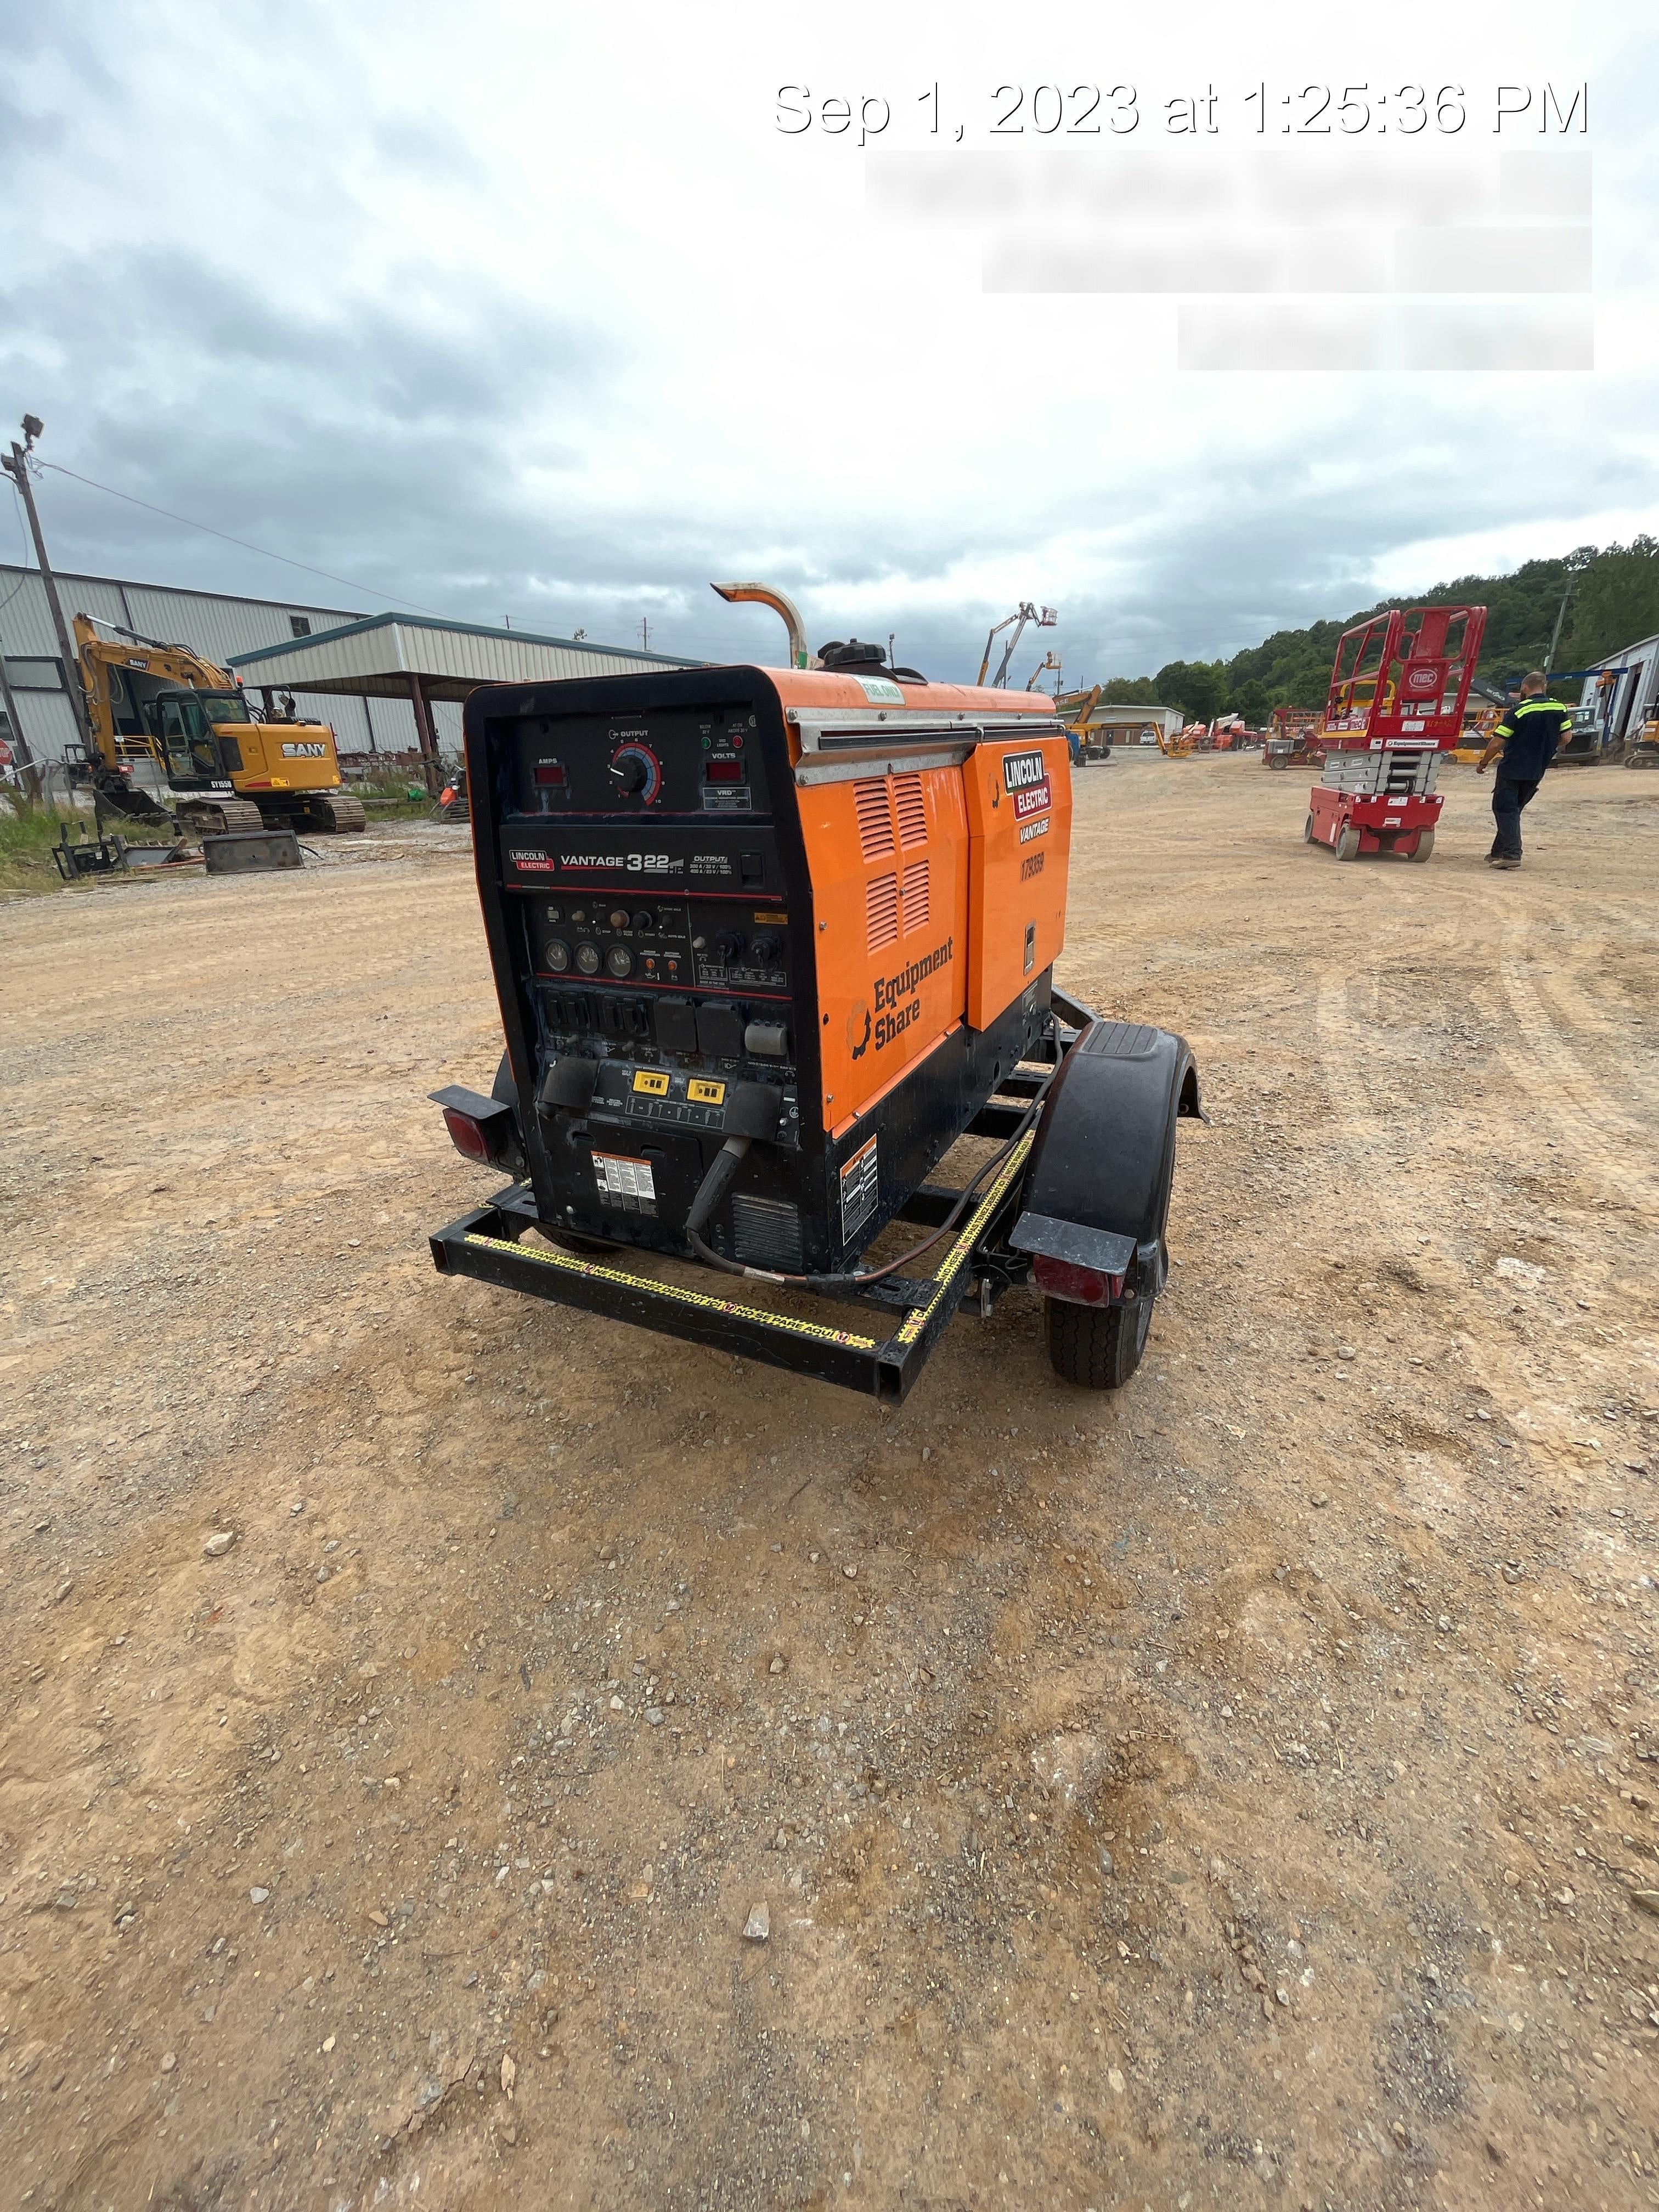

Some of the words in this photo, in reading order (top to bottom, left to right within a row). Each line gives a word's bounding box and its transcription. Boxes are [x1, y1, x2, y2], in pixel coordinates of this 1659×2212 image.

[129, 659, 146, 668] SANY
[862, 683, 884, 696] FUEL
[881, 685, 900, 698] ONLY
[1054, 698, 1069, 706] ASE
[281, 743, 325, 758] SANY
[1005, 757, 1043, 788] LINCOLN
[1018, 787, 1048, 813] ELECTRIC
[1020, 819, 1050, 843] VANTAGE
[511, 852, 545, 861] LINCOLN
[560, 855, 624, 866] VANTAGE
[627, 854, 669, 871] 322
[874, 936, 953, 1013] Equipment
[874, 998, 920, 1051] Share
[950, 1251, 962, 1268] HERE
[962, 1235, 972, 1244] NE
[968, 1224, 979, 1235] PAS
[975, 1207, 990, 1223] TENEZ
[526, 1250, 558, 1261] STAND
[557, 1258, 585, 1269] HERE
[608, 1272, 629, 1281] PAS
[628, 1278, 664, 1290] TENEZ
[662, 1287, 706, 1302] DEBOUT
[735, 1307, 754, 1316] NO
[771, 1317, 804, 1329] PARE
